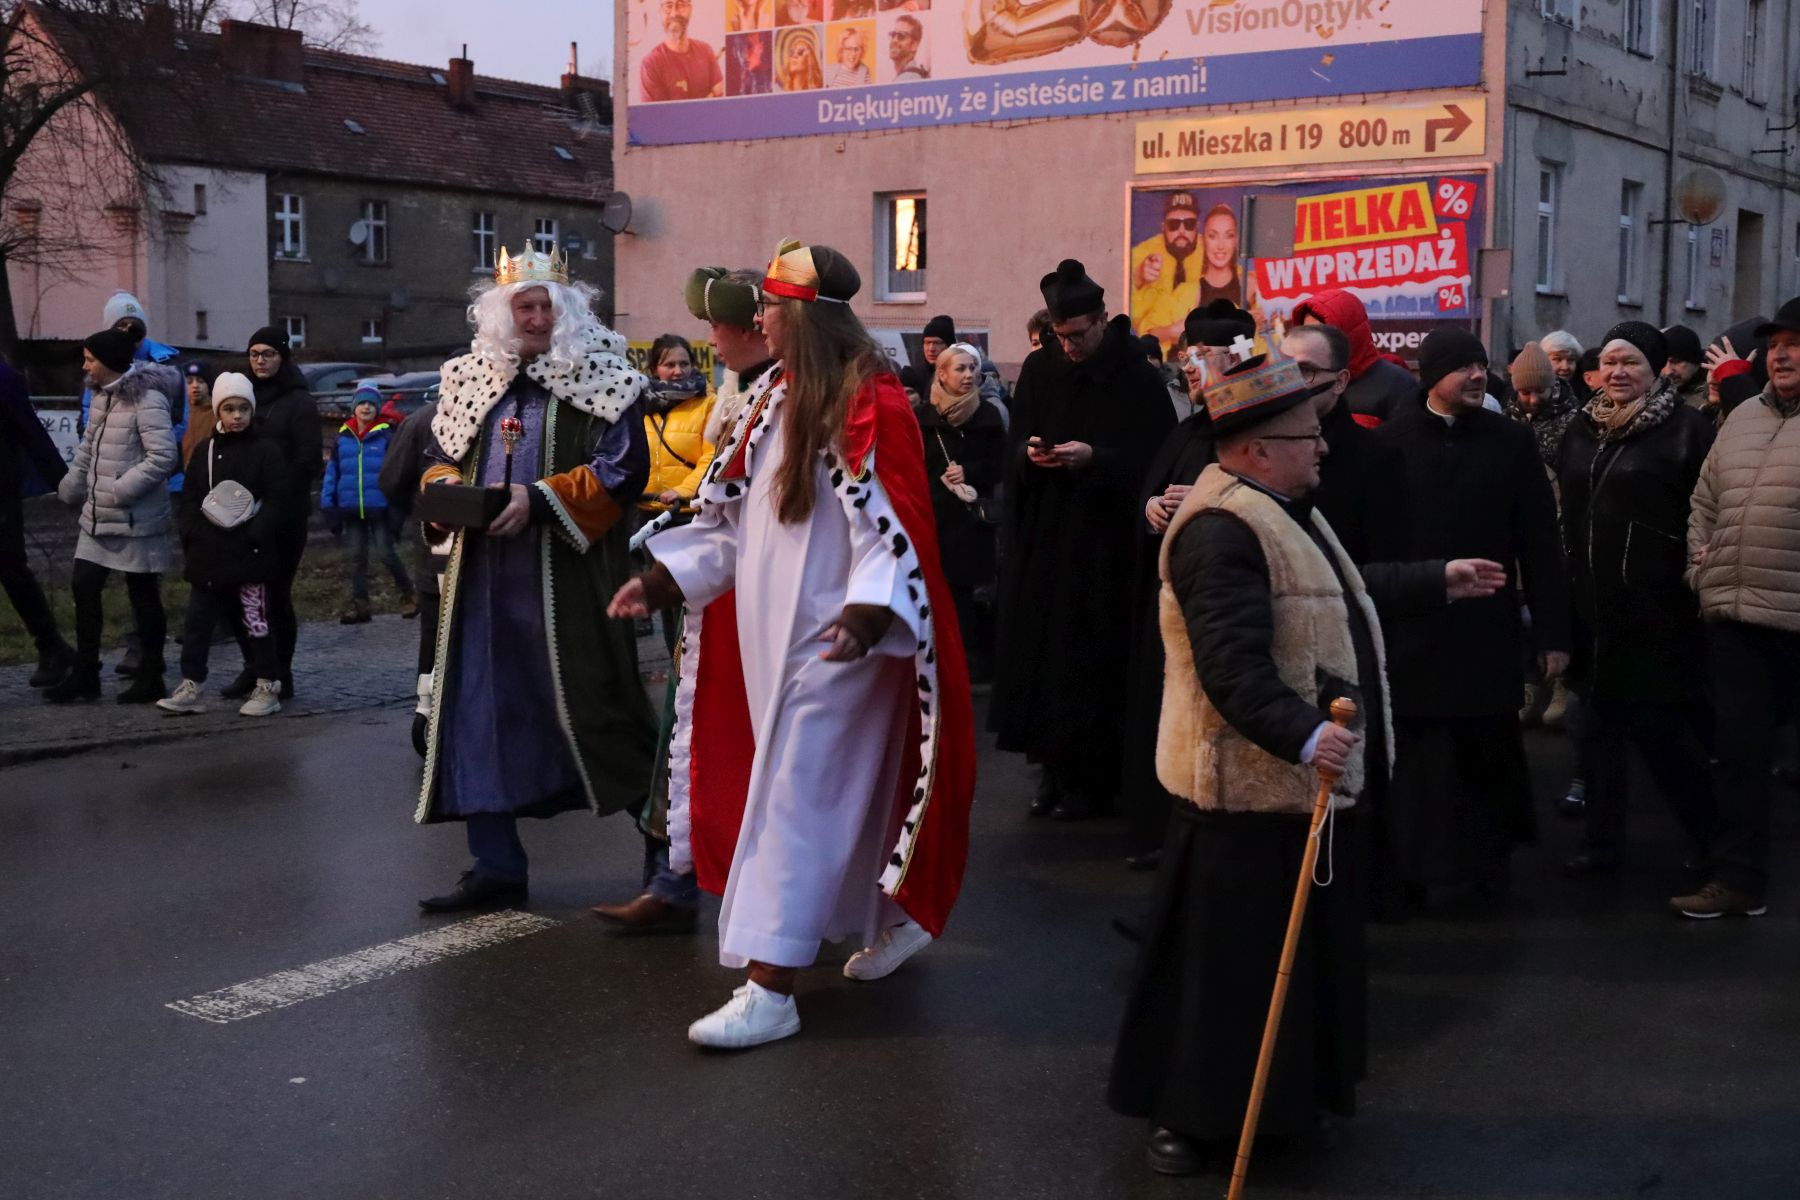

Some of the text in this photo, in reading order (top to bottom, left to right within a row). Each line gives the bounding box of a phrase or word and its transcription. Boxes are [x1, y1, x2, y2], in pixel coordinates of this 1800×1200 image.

[1185, 0, 1374, 36] VisionOptyk
[817, 65, 1208, 125] Dziękujemy, że jesteście z nami!
[1142, 118, 1411, 159] ul. Mieszka I 19 800 m
[1295, 188, 1428, 244] IELKA
[1265, 228, 1457, 290] WYPRZEDAŻ
